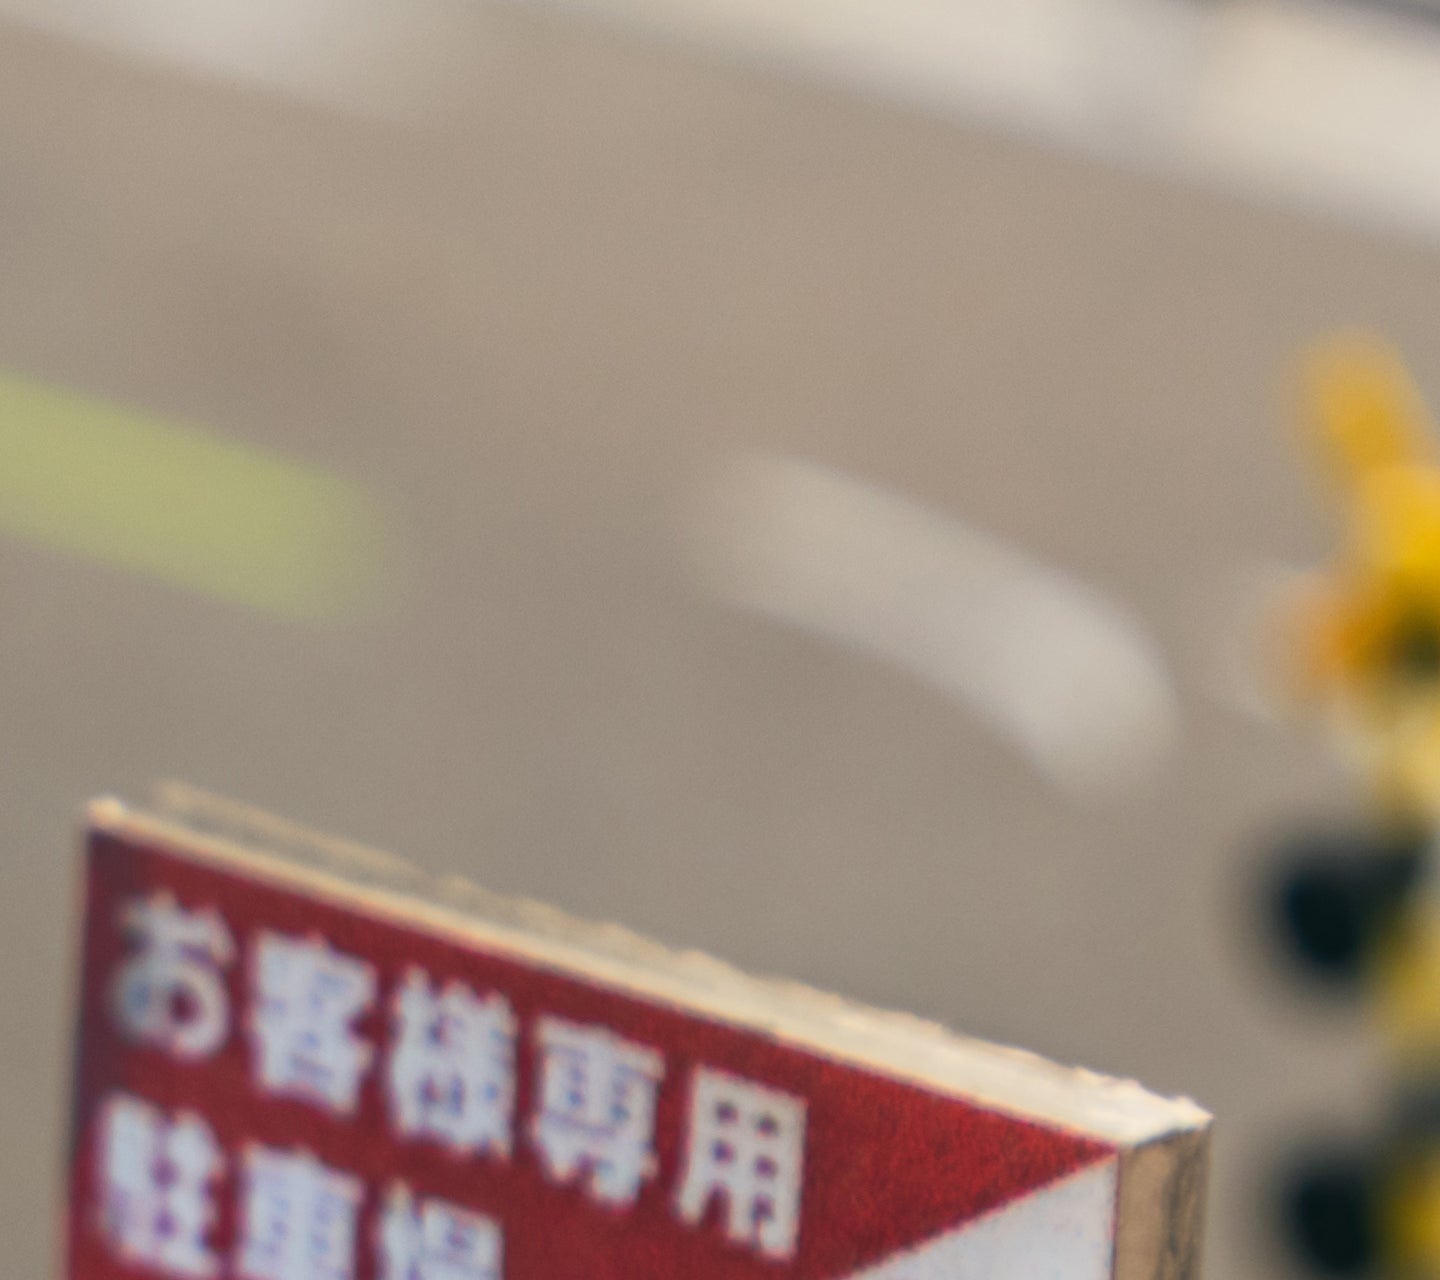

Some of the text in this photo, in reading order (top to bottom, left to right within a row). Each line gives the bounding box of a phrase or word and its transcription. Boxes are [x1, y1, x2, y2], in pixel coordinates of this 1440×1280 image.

[112, 895, 807, 1260] お客様専用
